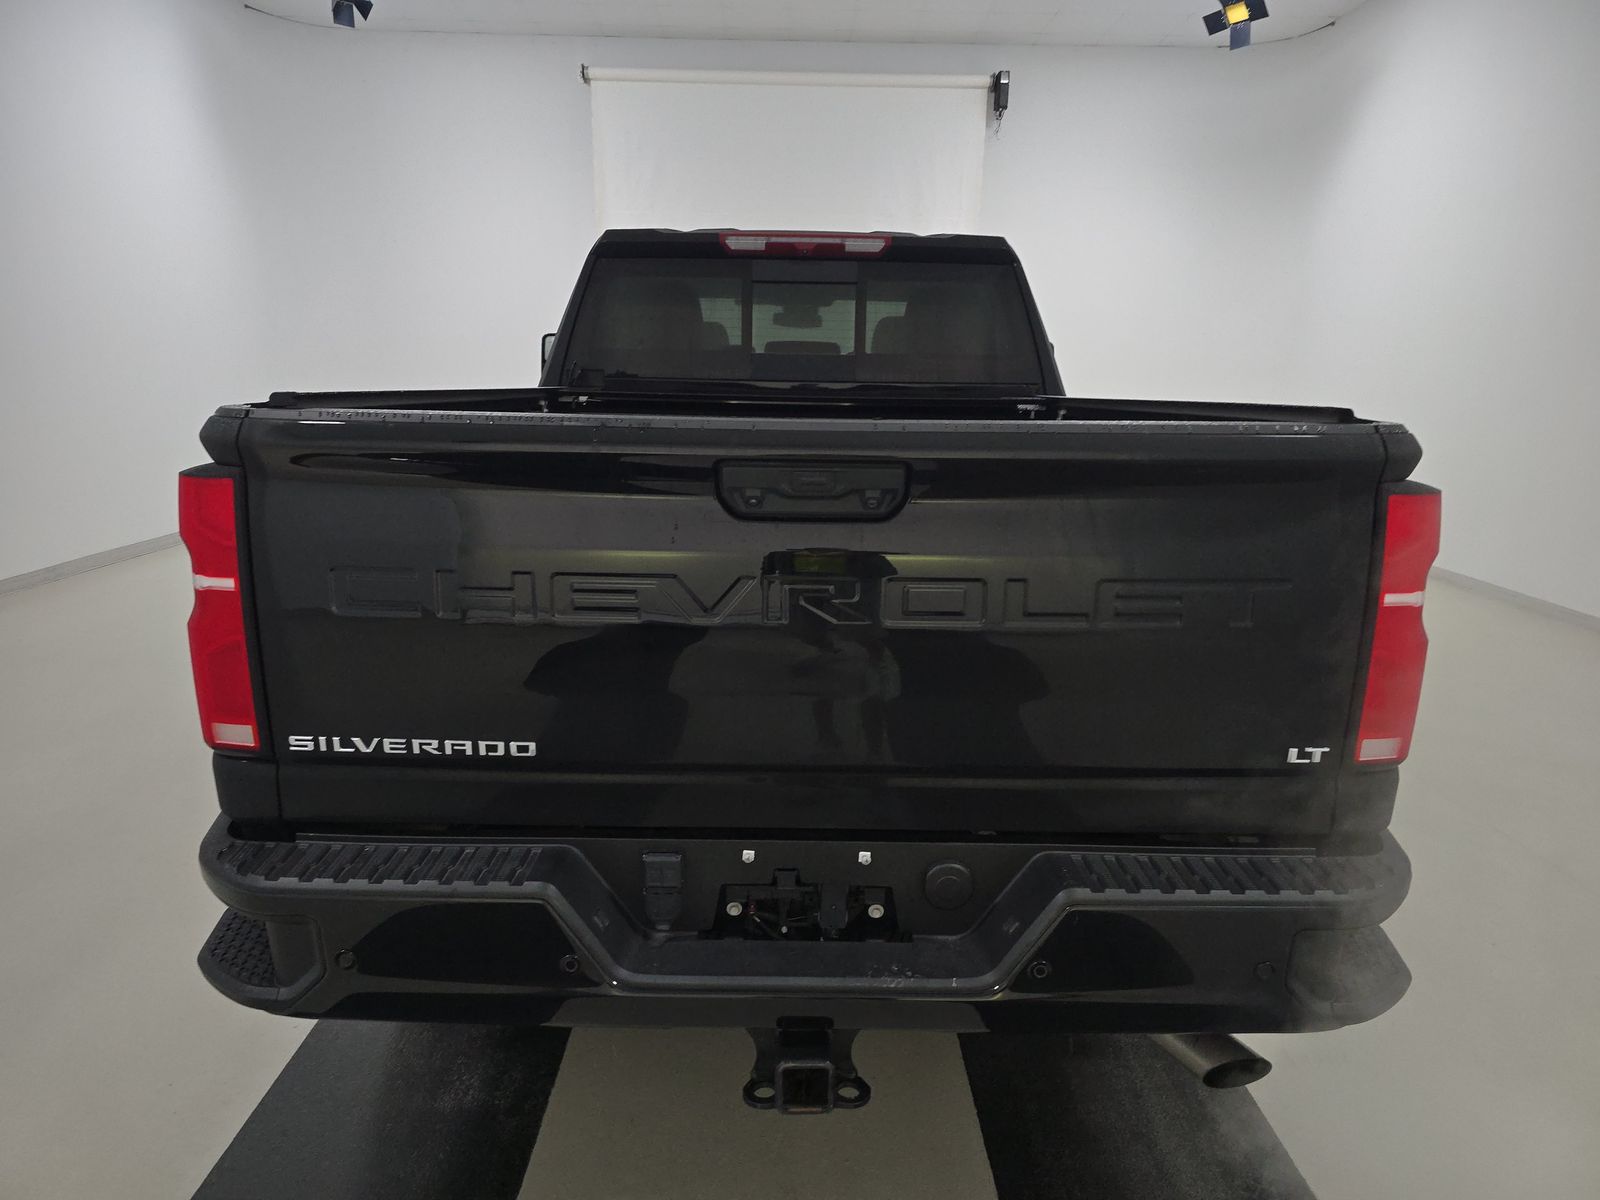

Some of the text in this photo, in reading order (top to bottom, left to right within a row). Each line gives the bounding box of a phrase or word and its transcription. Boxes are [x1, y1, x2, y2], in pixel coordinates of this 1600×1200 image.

[328, 565, 1293, 629] CHEVROLET
[288, 735, 537, 757] SILVERADO
[1286, 746, 1331, 763] LT
